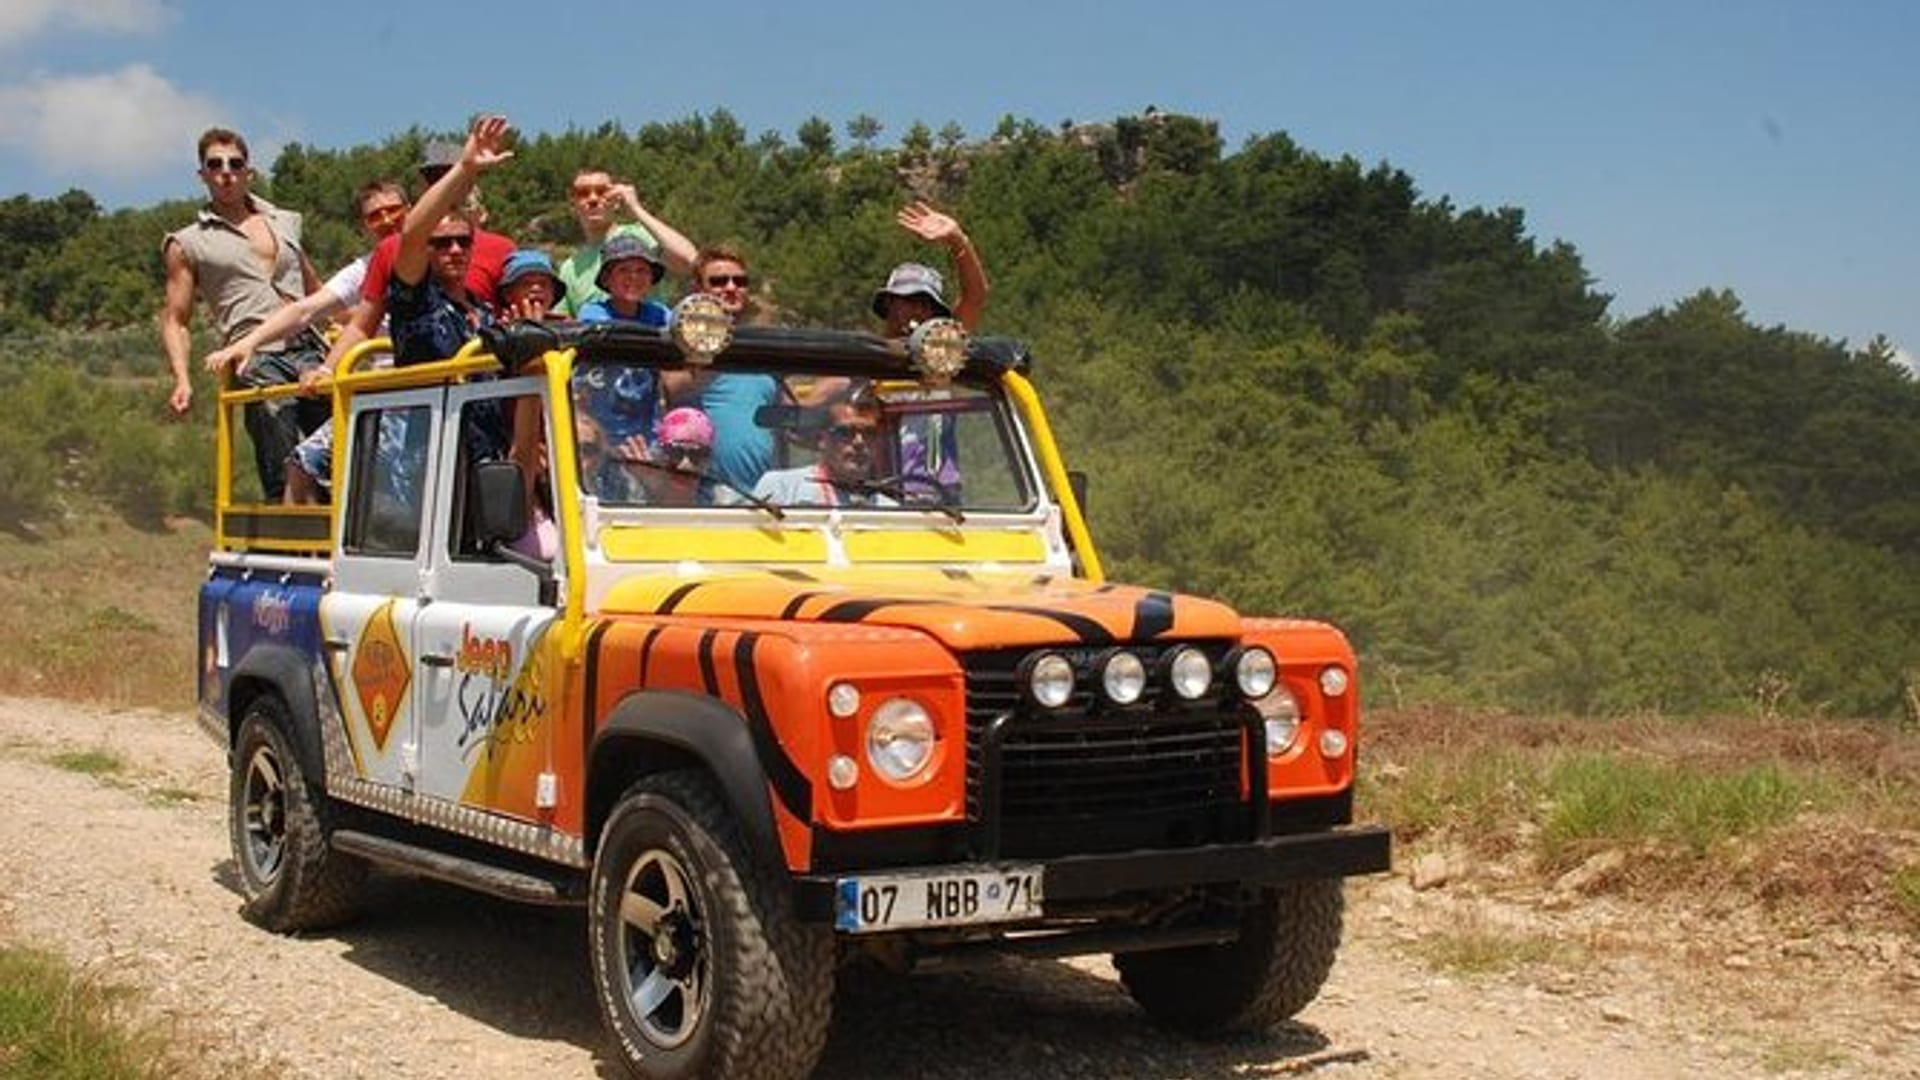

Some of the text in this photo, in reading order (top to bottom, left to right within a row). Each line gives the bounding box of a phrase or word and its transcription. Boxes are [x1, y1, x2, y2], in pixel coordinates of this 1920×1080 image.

[456, 622, 512, 684] Jeep
[861, 885, 898, 924] 07
[926, 880, 979, 920] NBB
